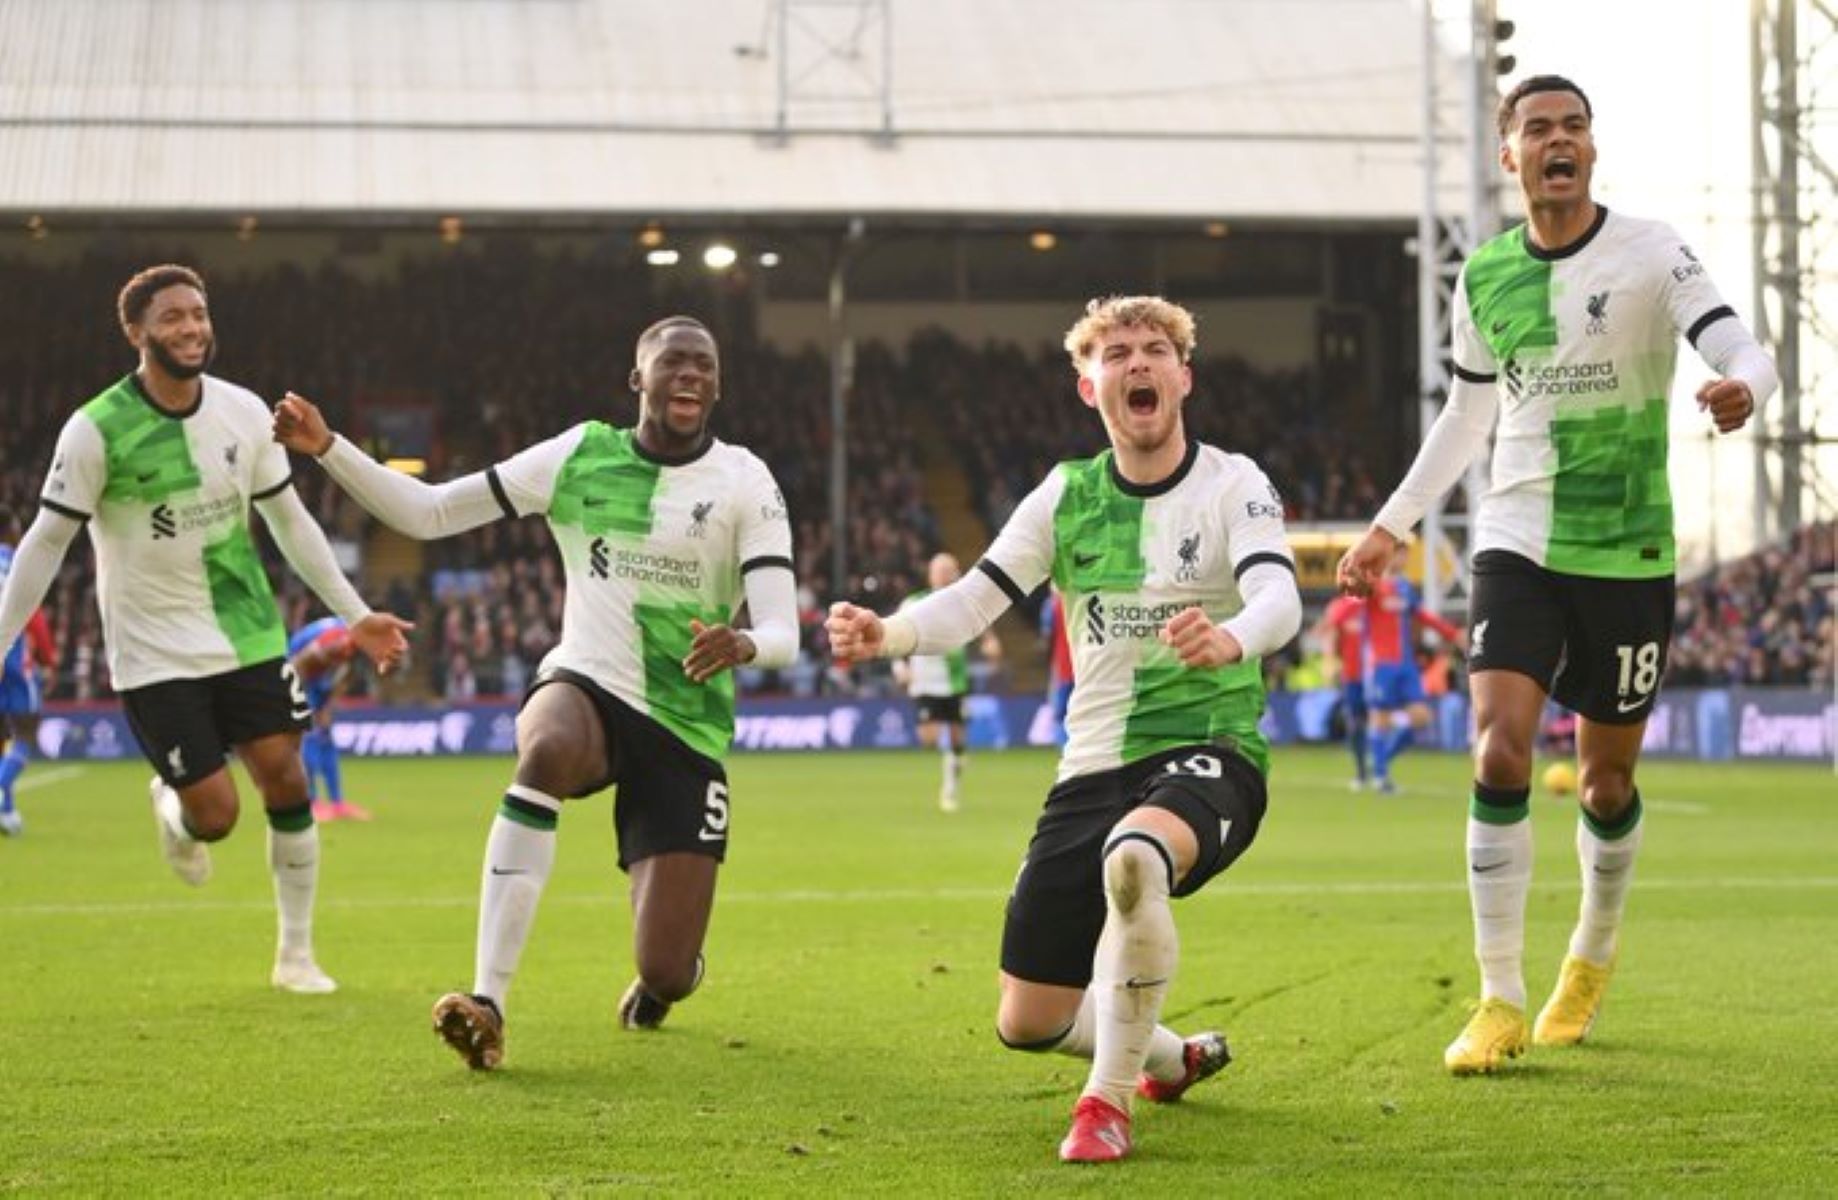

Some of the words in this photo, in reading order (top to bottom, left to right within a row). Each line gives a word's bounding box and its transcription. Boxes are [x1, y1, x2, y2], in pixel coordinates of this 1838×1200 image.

[1112, 599, 1202, 622] standa
[1617, 642, 1659, 696] 18
[704, 781, 727, 830] 5
